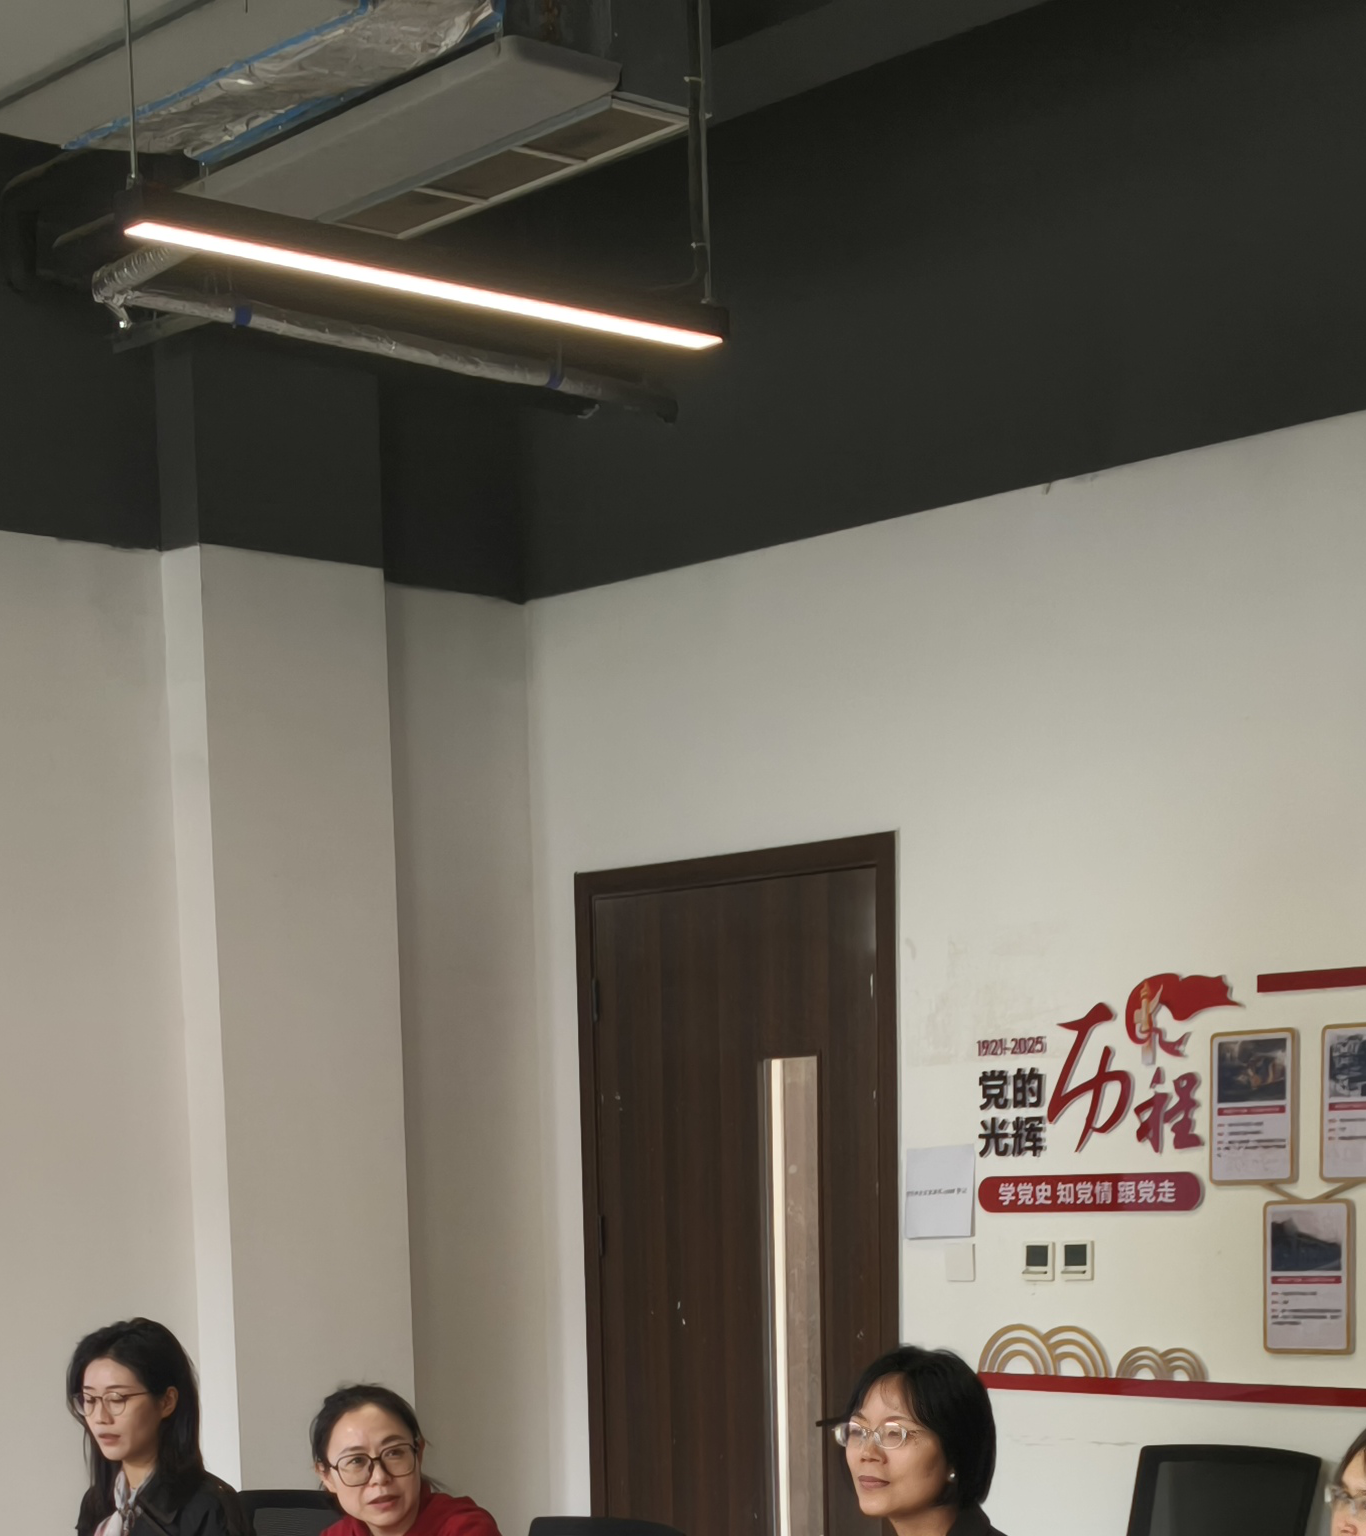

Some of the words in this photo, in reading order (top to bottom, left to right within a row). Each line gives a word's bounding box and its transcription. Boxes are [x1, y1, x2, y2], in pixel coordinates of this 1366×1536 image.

[978, 1067, 1045, 1110] 党的
[978, 1116, 1046, 1158] 光辉
[998, 1182, 1052, 1206] 学党史
[1056, 1181, 1112, 1206] 知党情
[1117, 1179, 1176, 1204] 跟党走
